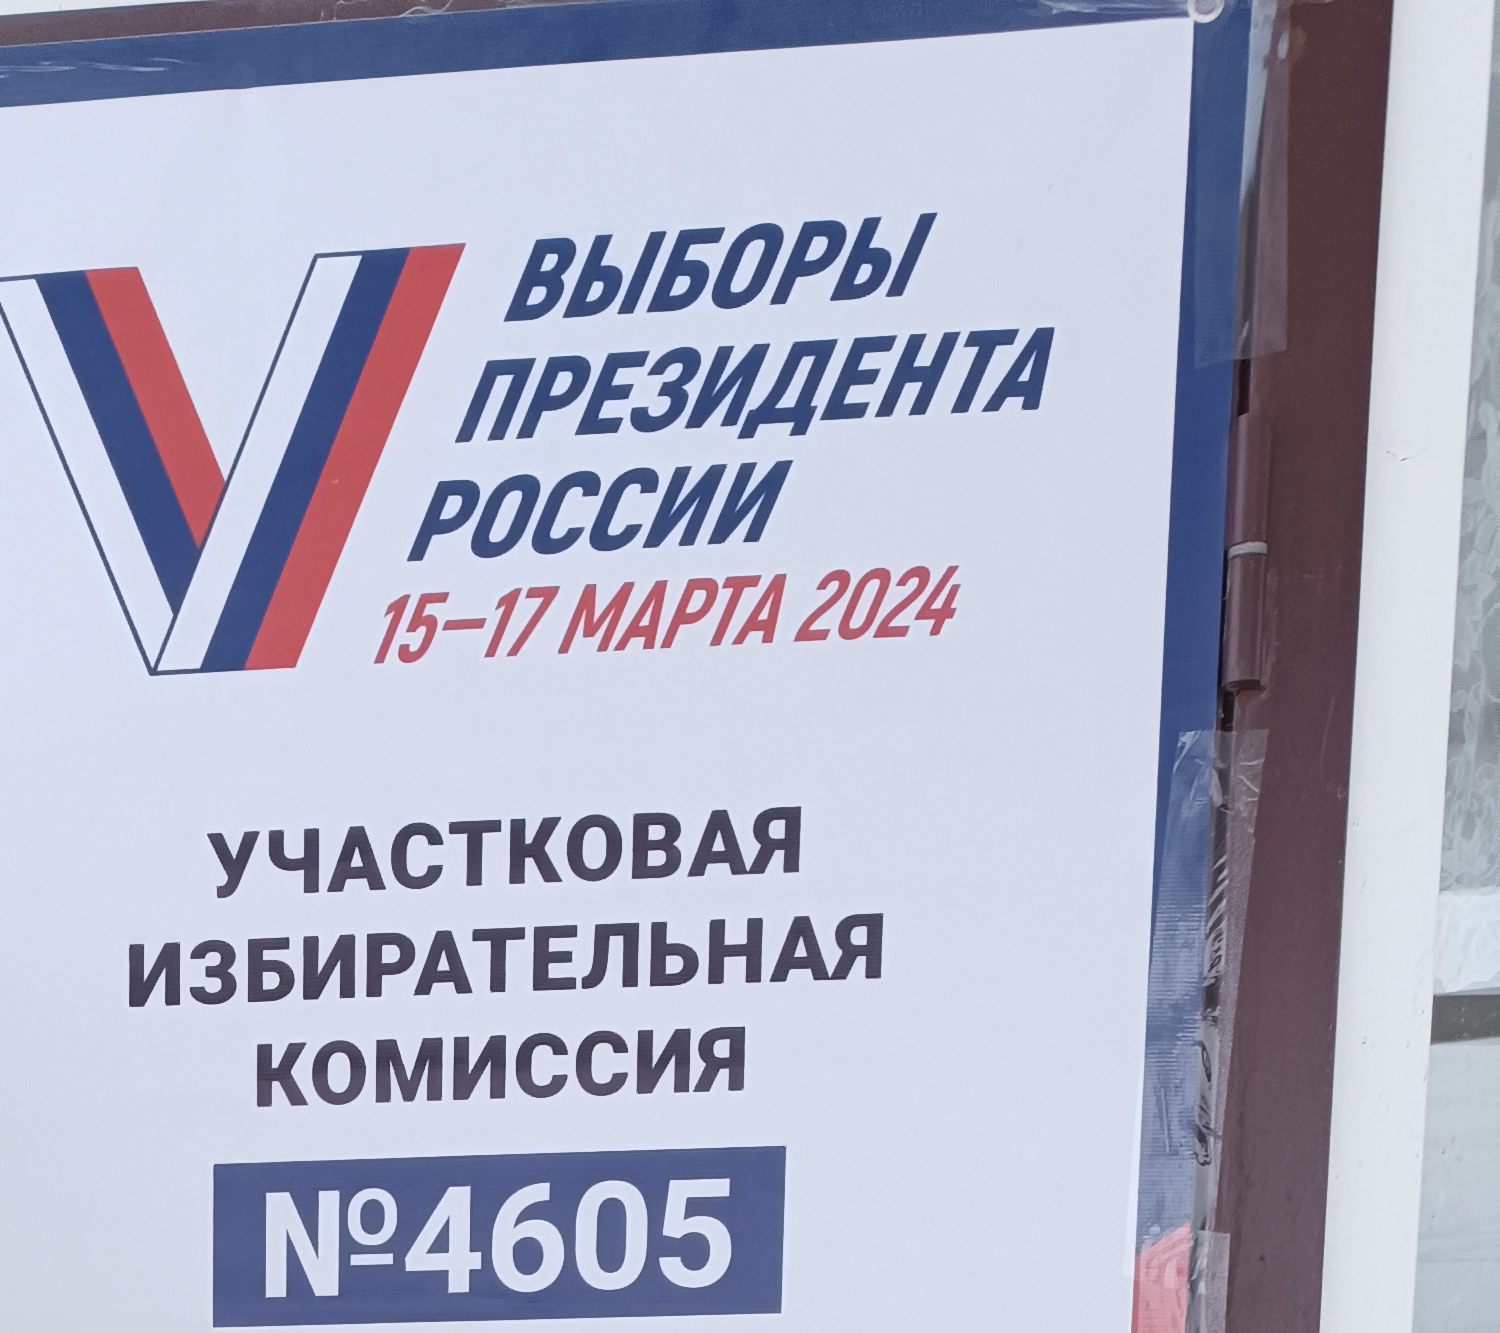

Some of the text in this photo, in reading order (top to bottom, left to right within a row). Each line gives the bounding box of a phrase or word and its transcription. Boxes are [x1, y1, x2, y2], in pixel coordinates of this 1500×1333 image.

[503, 212, 938, 323] ВЫБОРЫ
[454, 326, 1055, 444] ПРЕЗИДЕНТА
[406, 459, 794, 562] РОССИИ
[557, 573, 787, 655] МАРТА
[793, 564, 961, 643] 2024
[206, 805, 802, 899] УЧАСТКОВАЯ
[128, 912, 884, 1008] ИЗБИРАТЕЛЬНАЯ
[256, 1026, 746, 1108] КОМИССИЯ
[265, 1177, 733, 1299] №4605
